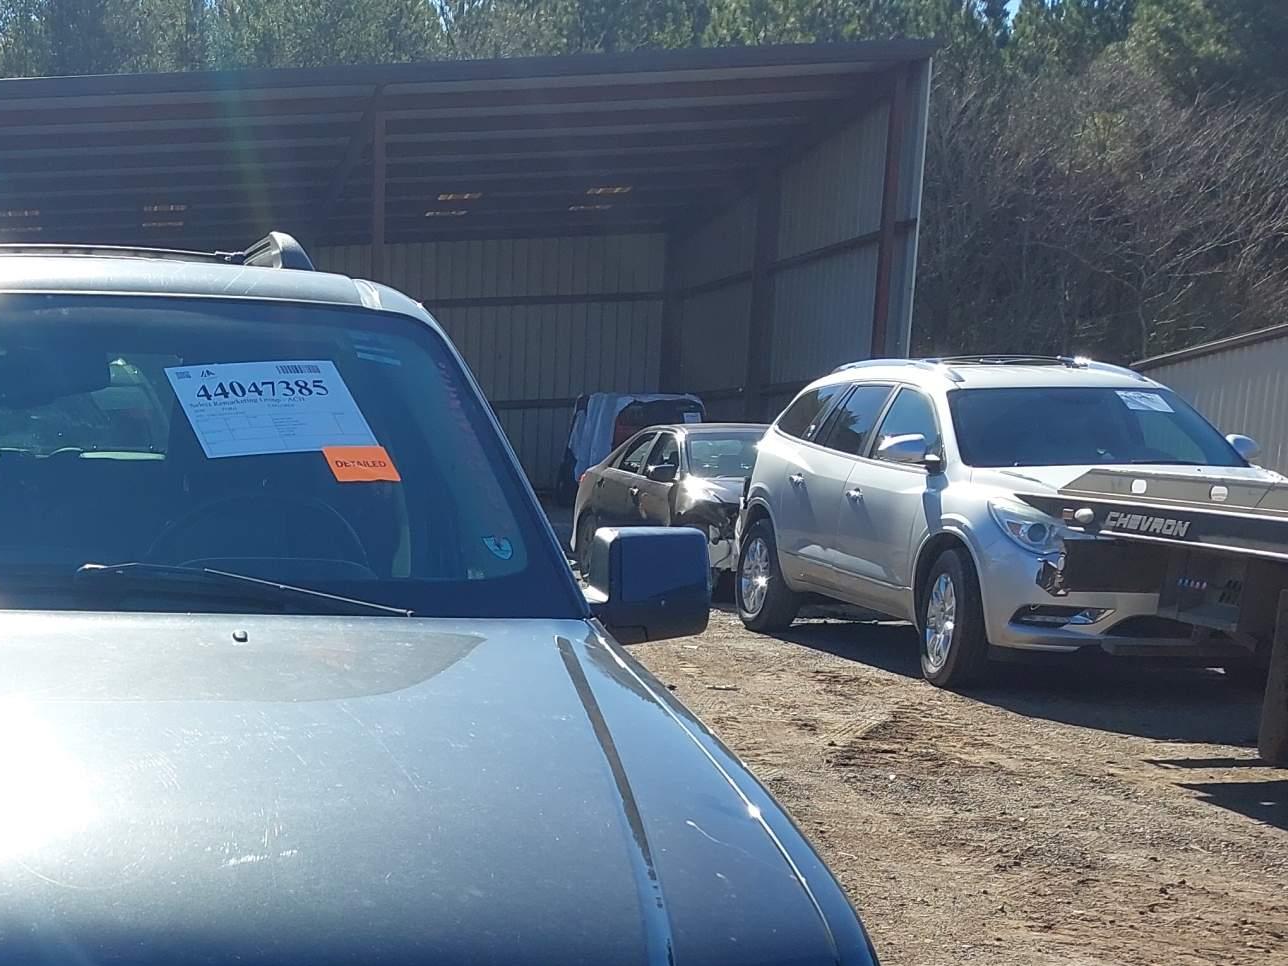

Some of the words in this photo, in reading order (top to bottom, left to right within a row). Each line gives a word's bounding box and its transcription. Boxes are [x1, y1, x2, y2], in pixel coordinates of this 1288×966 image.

[195, 379, 329, 401] 44047385
[334, 459, 387, 469] DETAILED
[1104, 511, 1192, 538] CHEVRON
